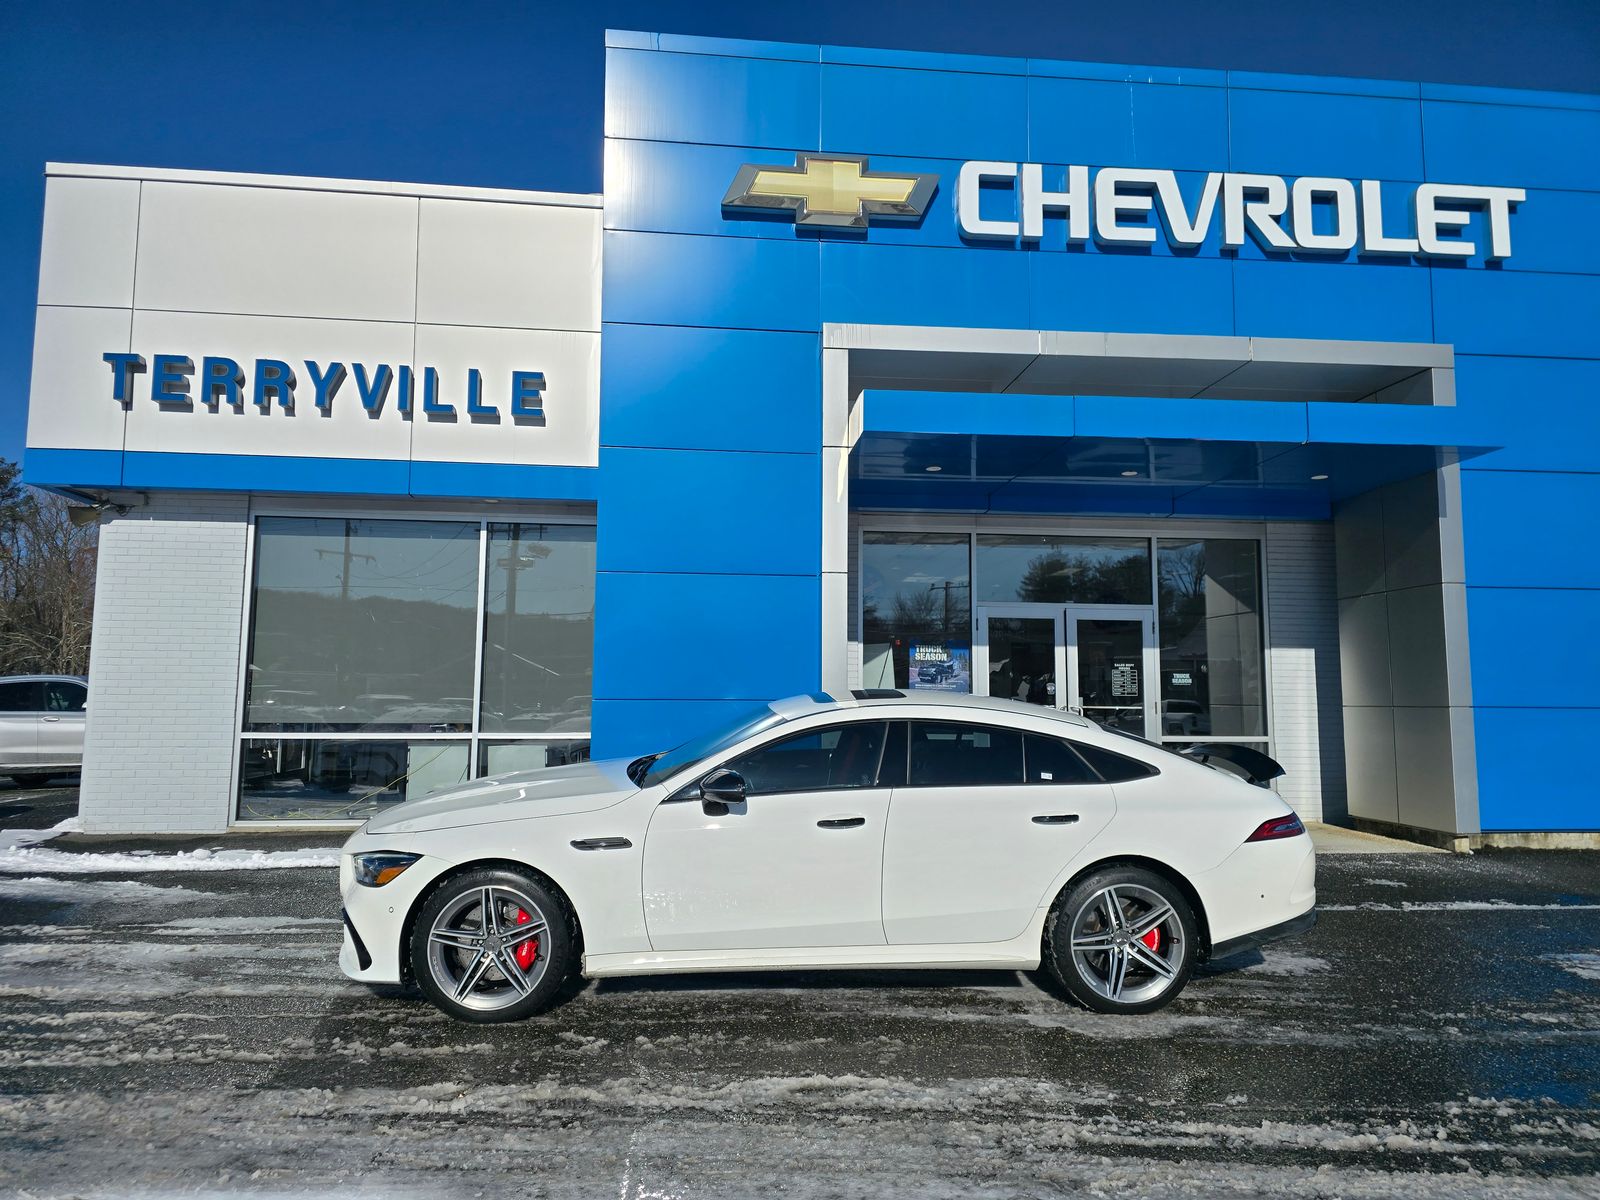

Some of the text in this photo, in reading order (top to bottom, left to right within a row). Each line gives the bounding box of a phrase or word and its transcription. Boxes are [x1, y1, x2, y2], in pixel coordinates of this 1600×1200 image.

[957, 160, 1526, 263] CHEVROLET
[102, 352, 547, 425] TERRYVILLE
[915, 645, 942, 653] TRUCK
[915, 652, 948, 661] SEASON
